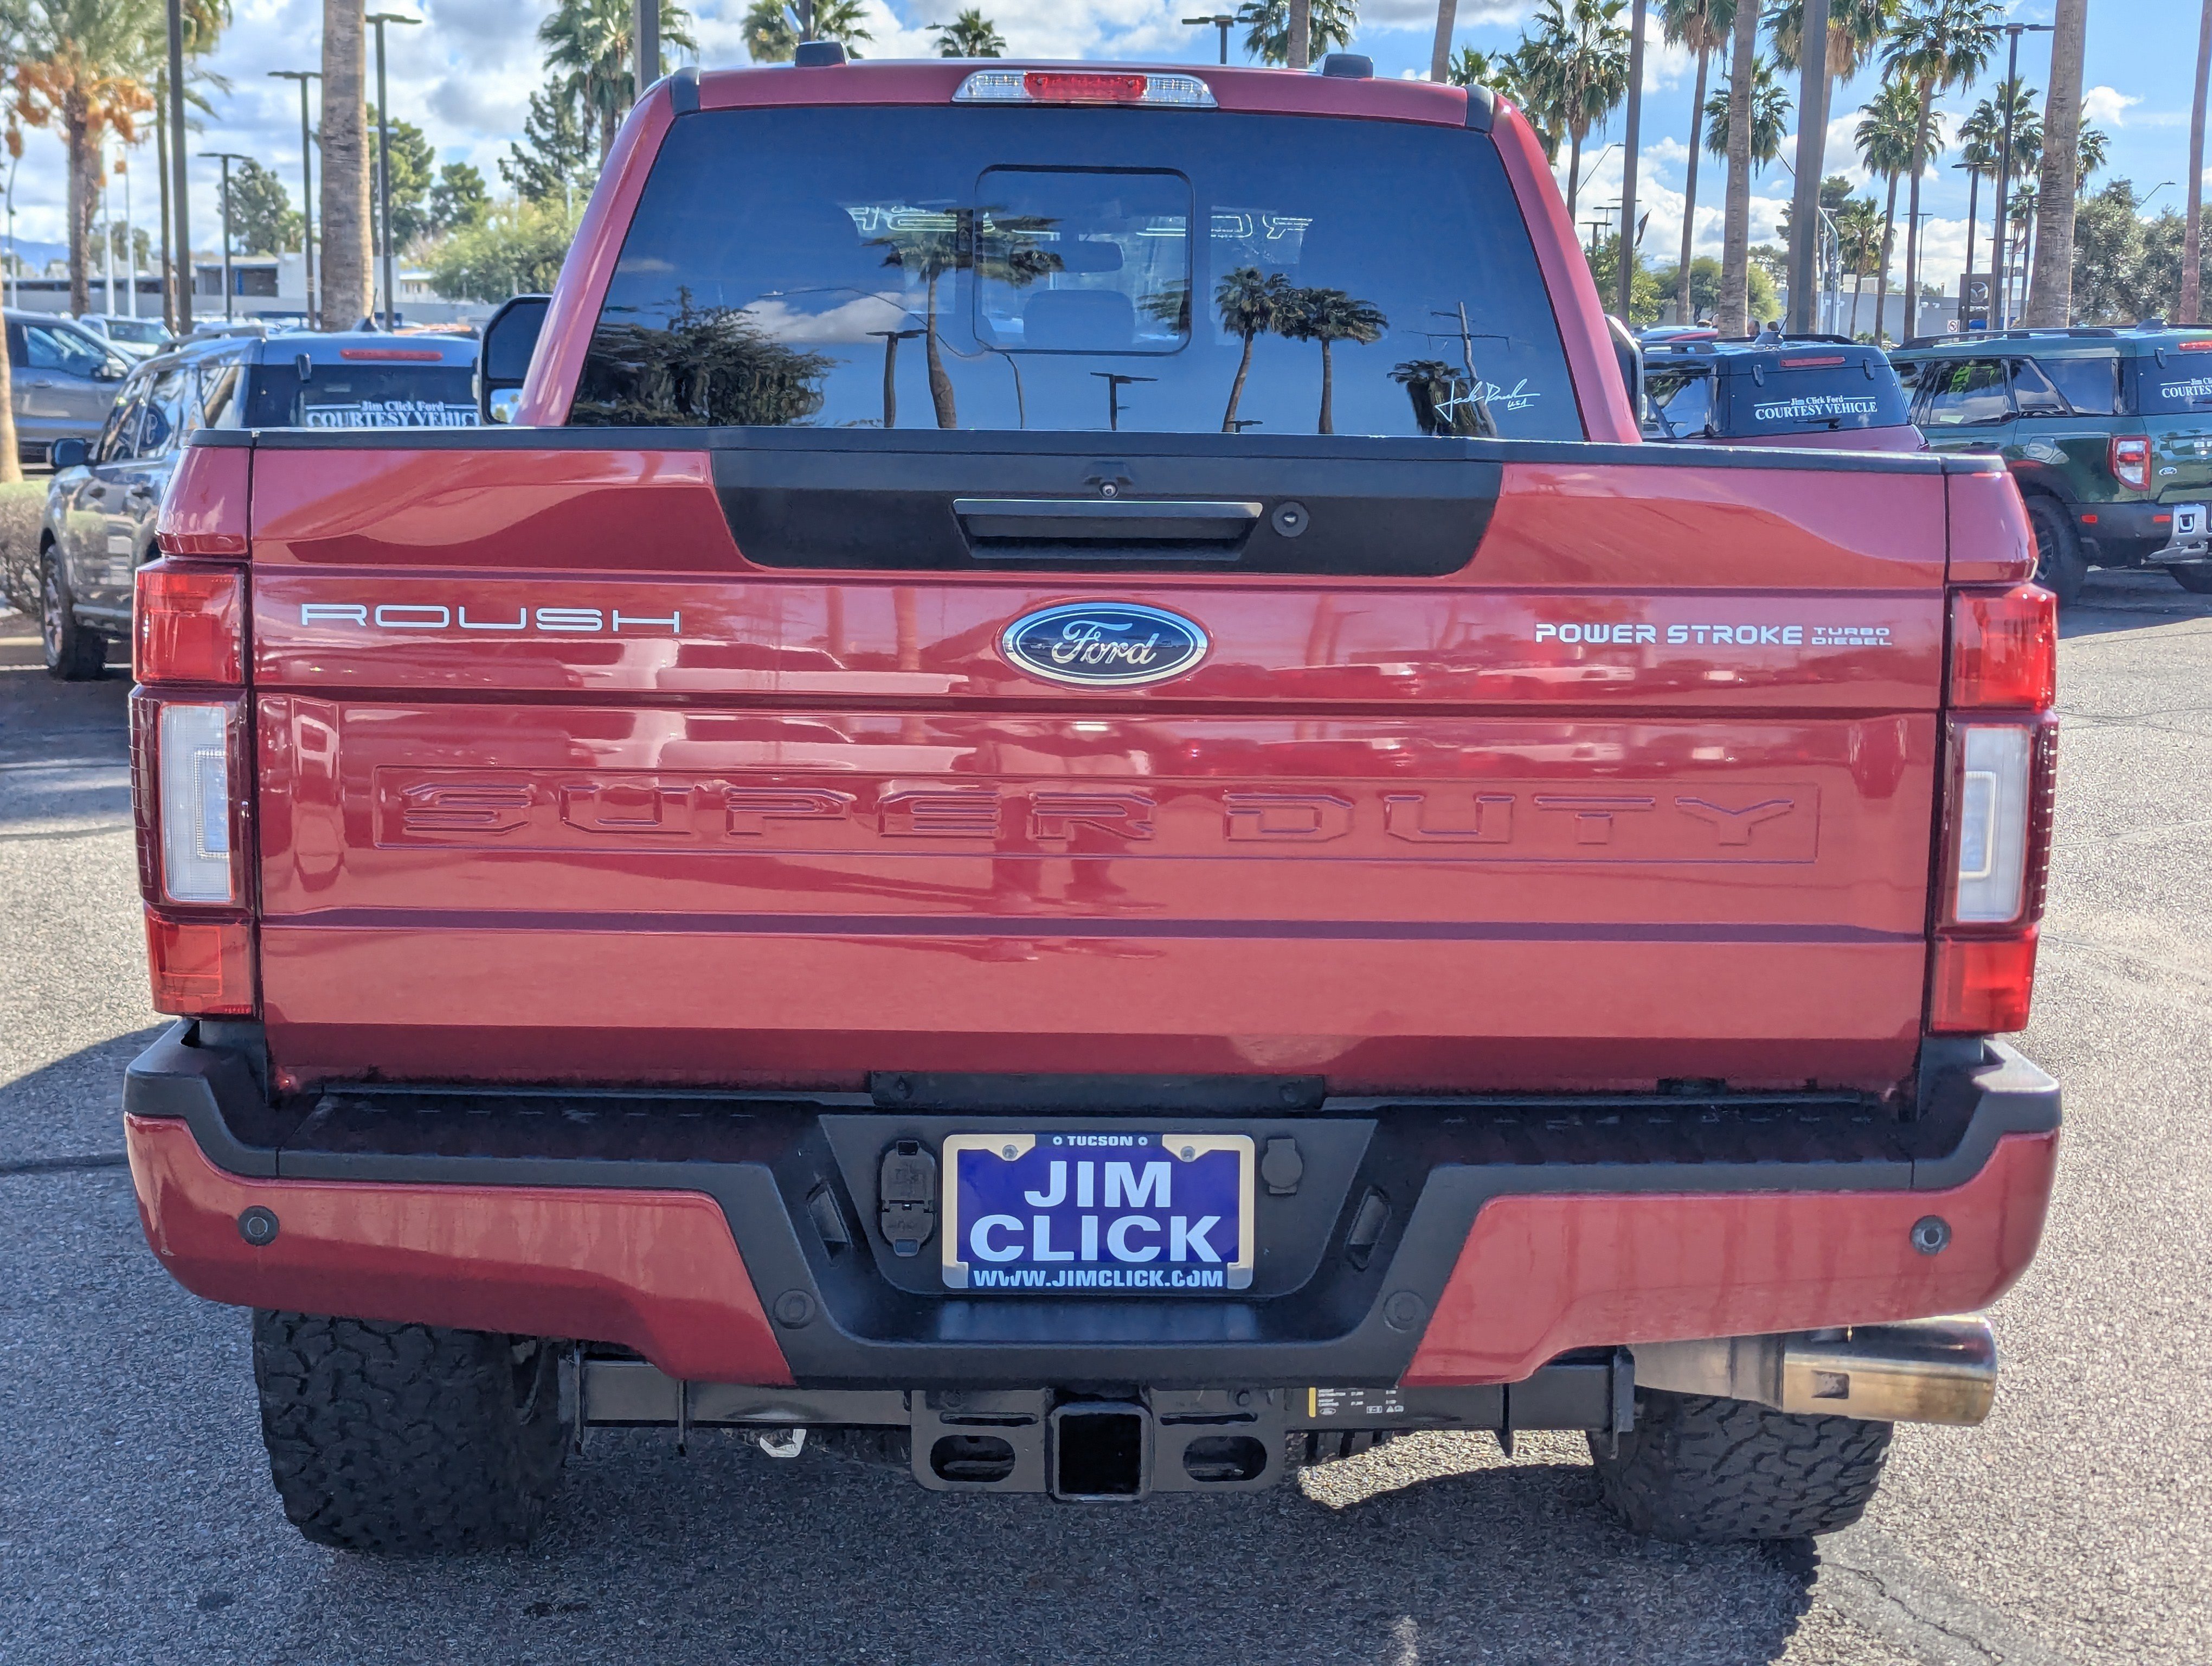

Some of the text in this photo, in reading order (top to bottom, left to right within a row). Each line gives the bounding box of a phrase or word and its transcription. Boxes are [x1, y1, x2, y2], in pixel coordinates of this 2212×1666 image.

[2162, 385, 2212, 398] COURTES
[307, 412, 410, 427] COURTESY
[1754, 401, 1877, 420] COURTESY VEHICLE
[301, 604, 680, 633] ROUSH
[1535, 624, 1803, 645] POWER STROKE
[1811, 637, 1893, 645] DIESEL
[1813, 627, 1890, 636] TURBO
[1051, 620, 1160, 664] Ford
[404, 782, 1796, 845] SUPER DUTY
[1067, 1135, 1133, 1147] TUCSON
[1024, 1160, 1172, 1208] JIM
[969, 1214, 1221, 1263] CLICK
[973, 1270, 1224, 1287] WWW.JIMCLICK.COM
